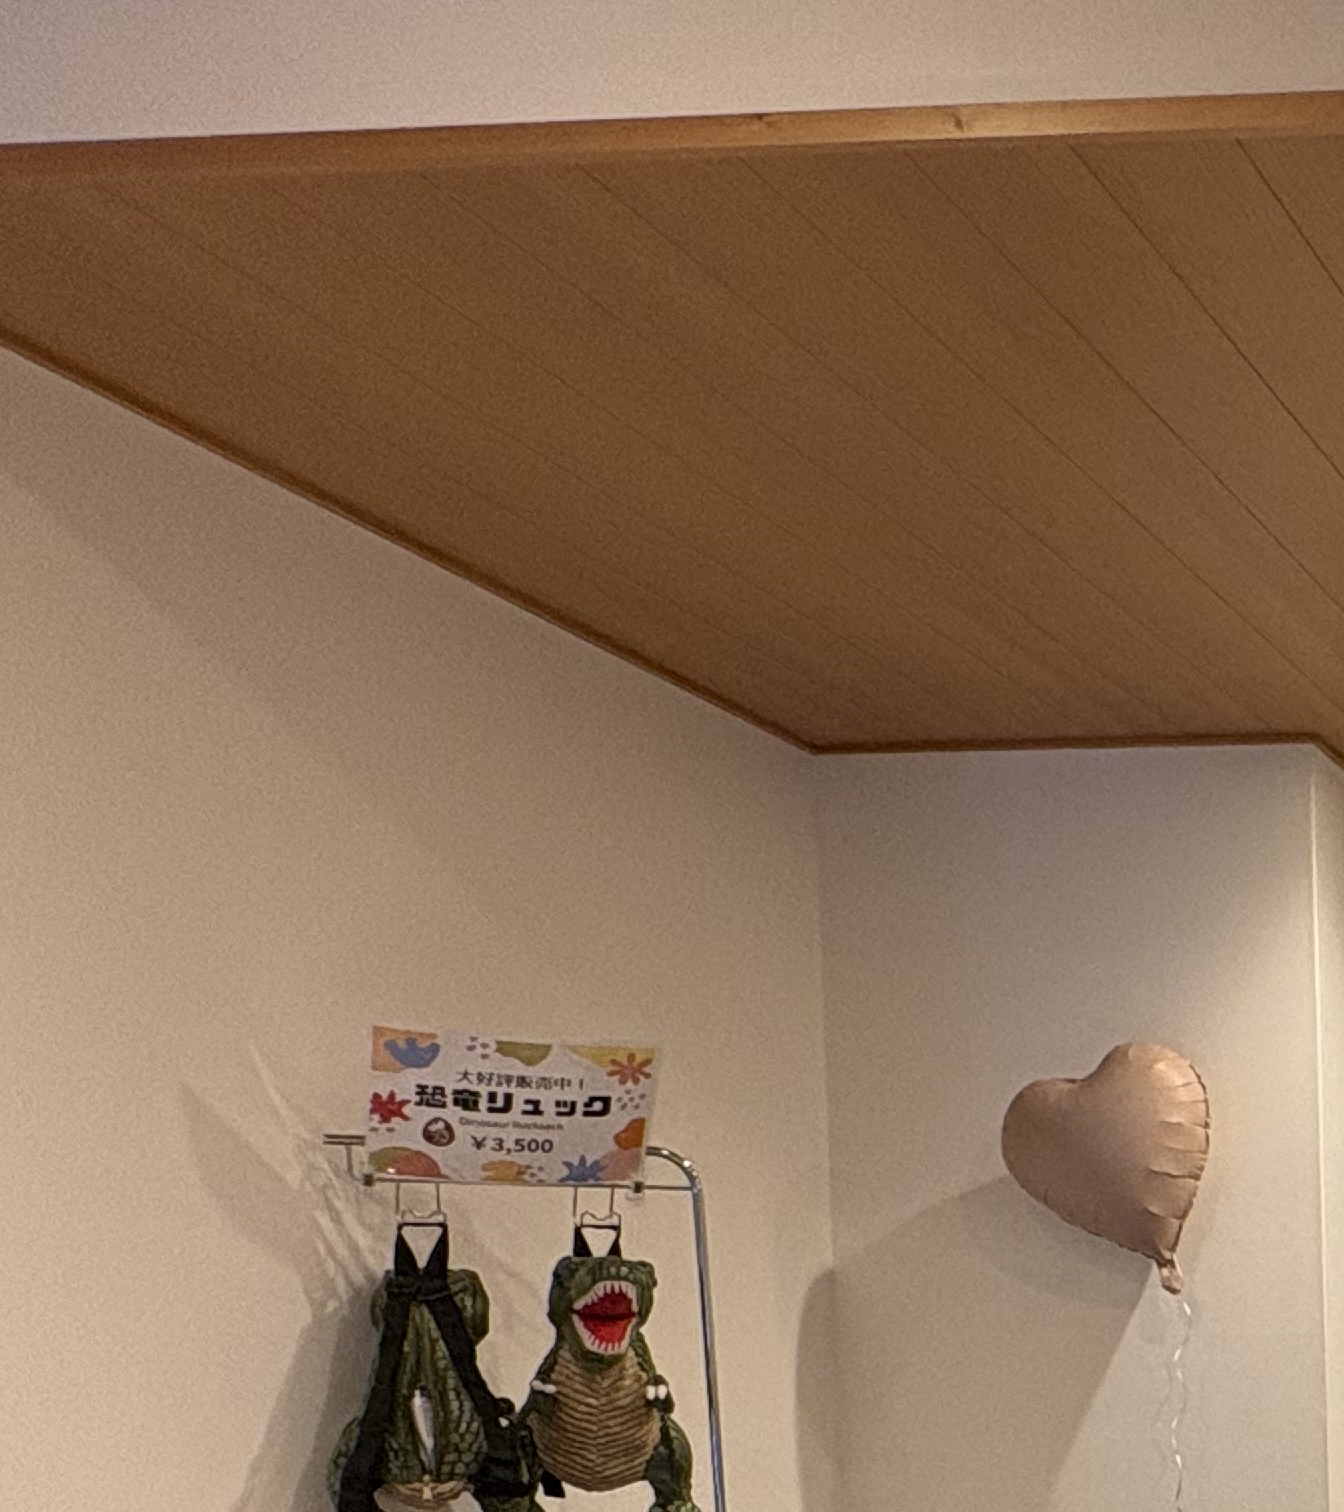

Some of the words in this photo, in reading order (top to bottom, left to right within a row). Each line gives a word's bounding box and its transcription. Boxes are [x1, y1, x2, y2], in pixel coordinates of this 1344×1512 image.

[414, 1083, 612, 1118] 恐竜リュック
